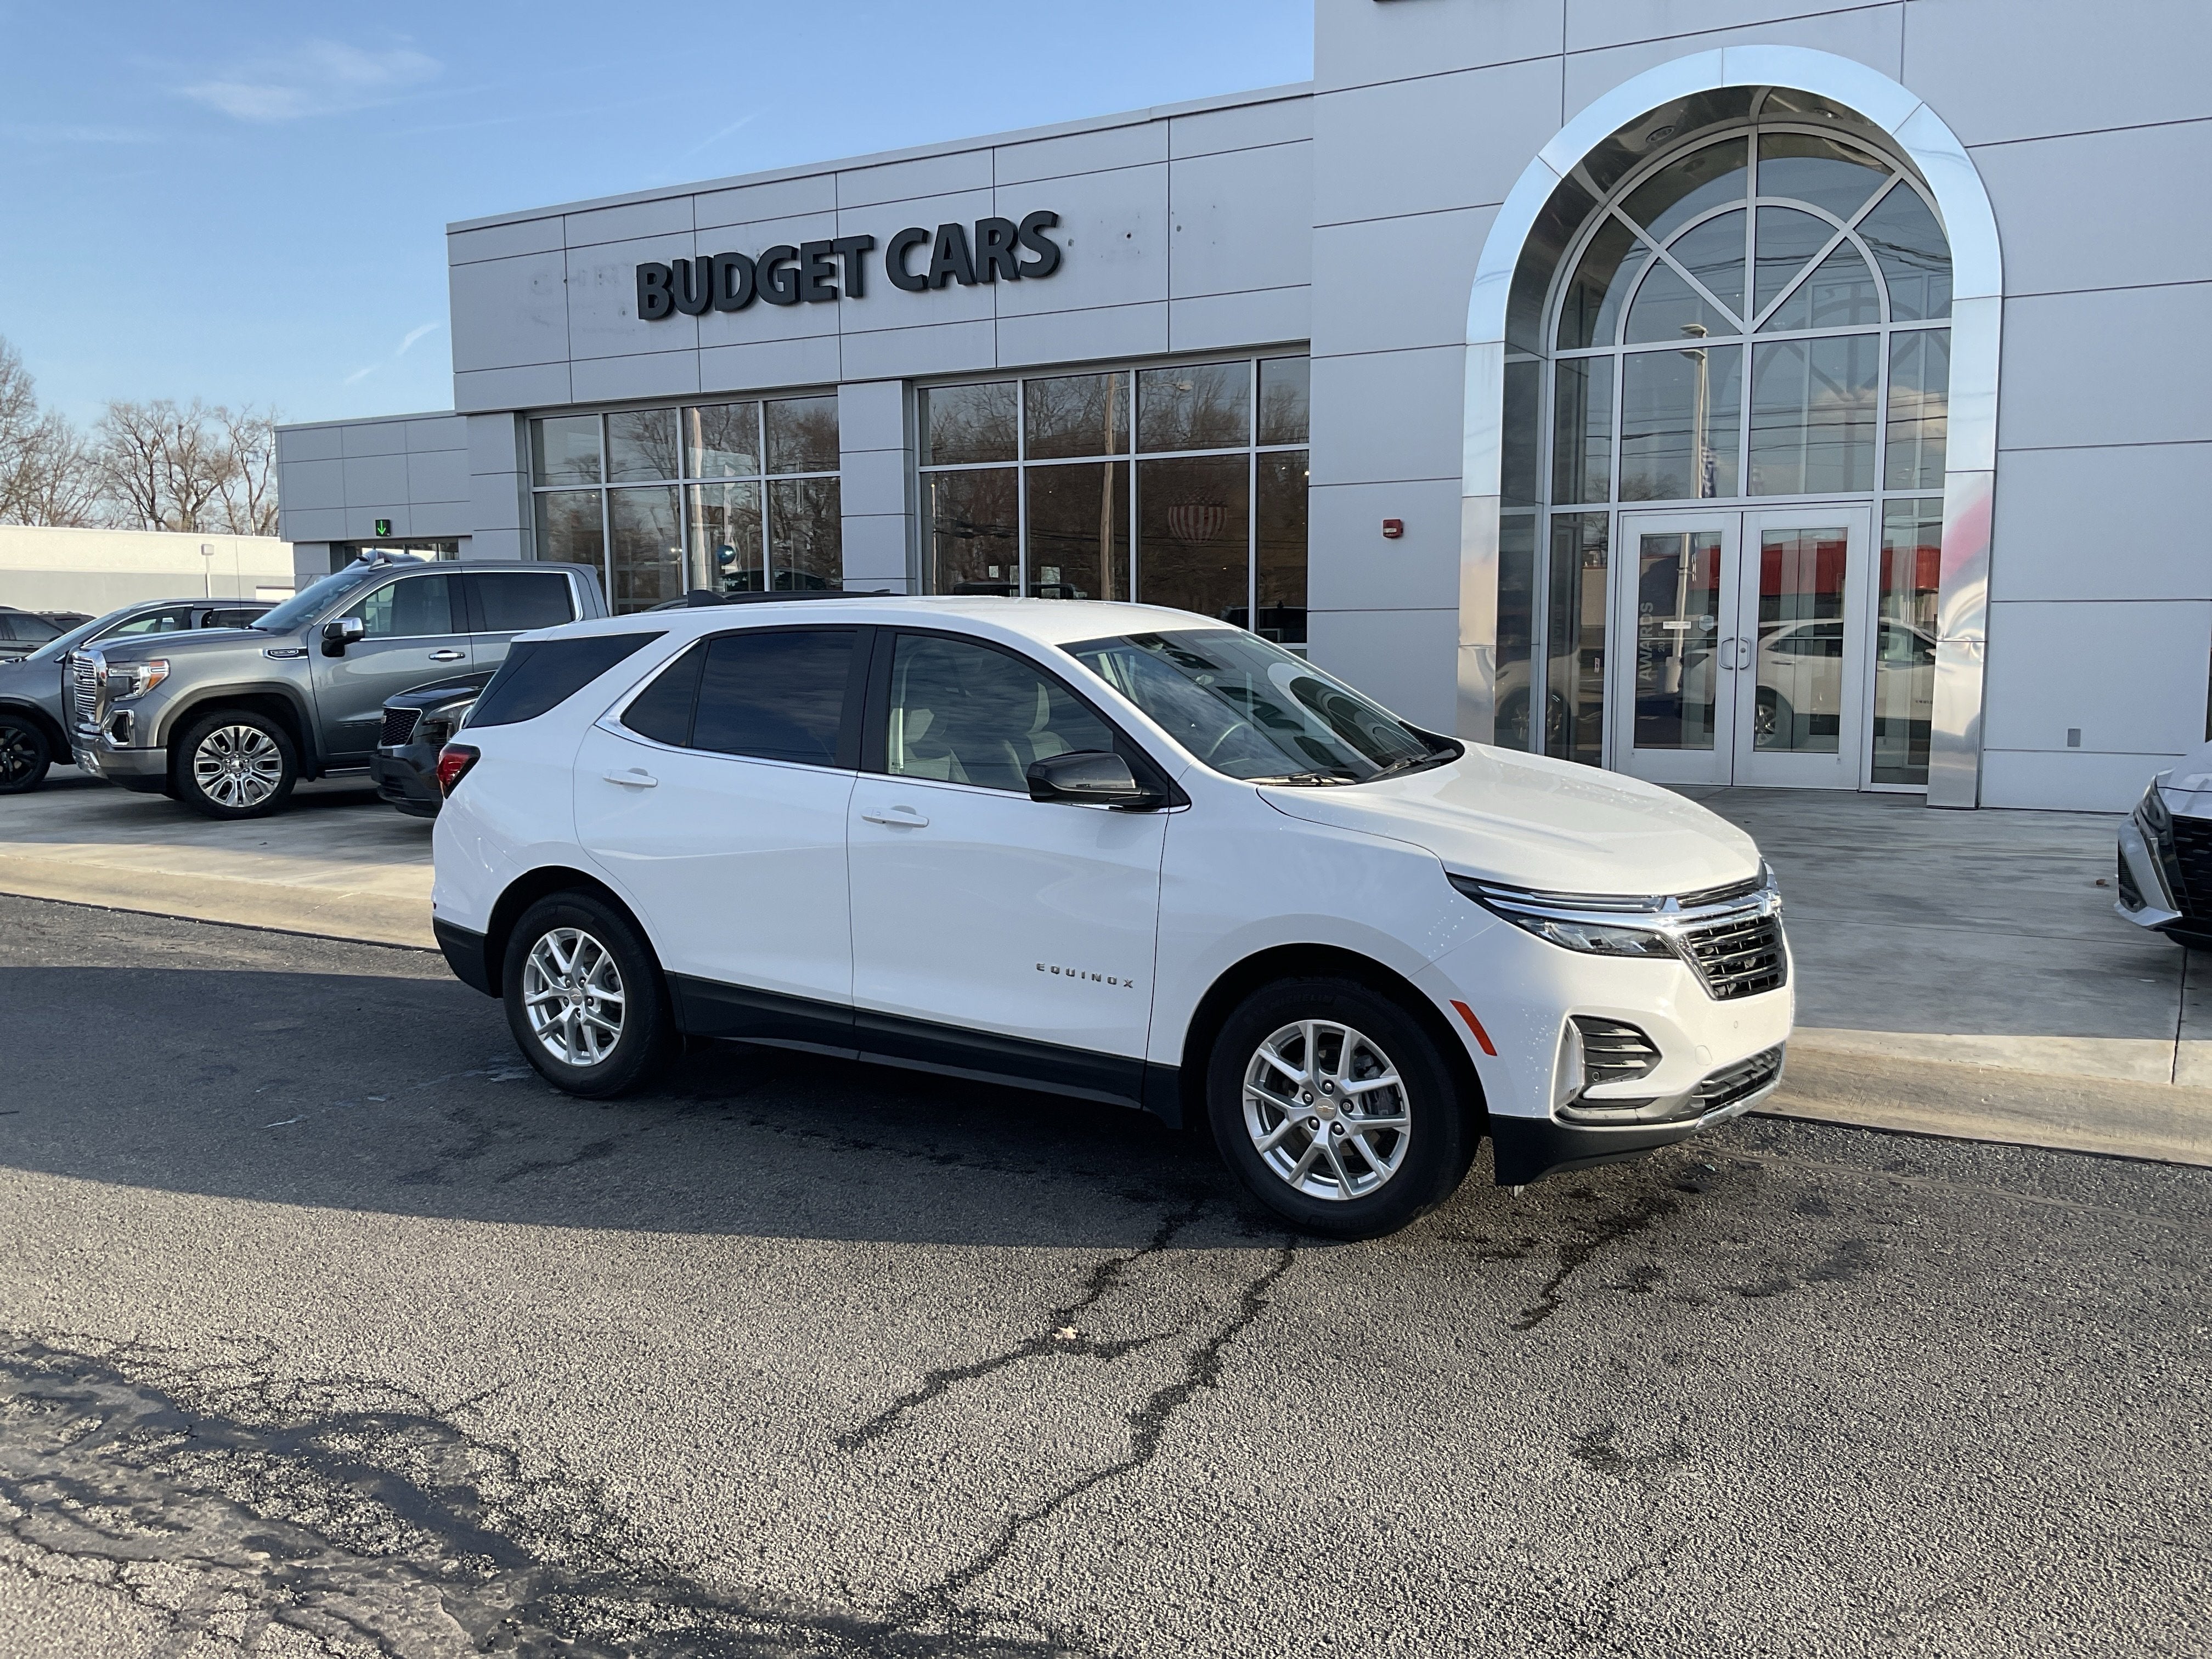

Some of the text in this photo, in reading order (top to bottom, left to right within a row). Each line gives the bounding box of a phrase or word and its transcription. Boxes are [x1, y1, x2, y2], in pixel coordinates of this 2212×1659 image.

[636, 210, 1061, 320] BUDGET CARS
[1639, 602, 1654, 681] AWARDS
[1036, 962, 1133, 989] EQUINOX
